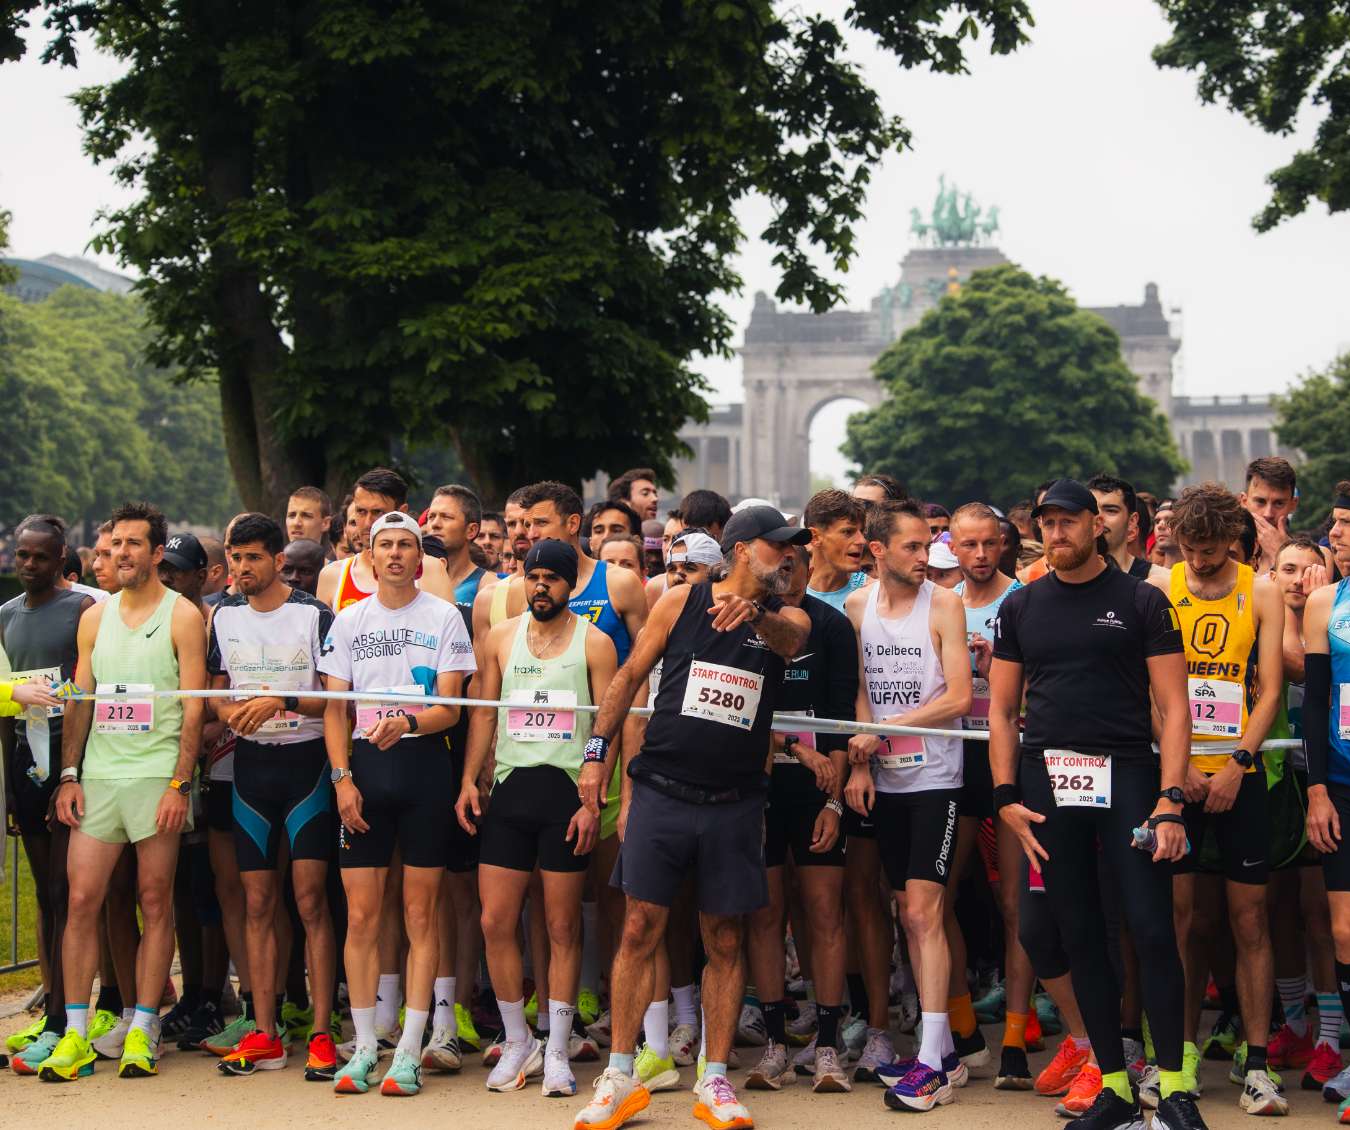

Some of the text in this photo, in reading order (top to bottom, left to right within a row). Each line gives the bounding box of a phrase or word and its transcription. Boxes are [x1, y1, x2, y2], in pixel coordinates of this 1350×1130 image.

[352, 628, 414, 648] ABSOLUTE
[353, 645, 403, 663] JOGGING
[877, 645, 922, 658] Delbecq
[1186, 660, 1241, 677] UEEN'S
[691, 667, 759, 691] START CONTROL
[698, 687, 746, 711] 5280
[1194, 689, 1217, 698] SPA
[107, 706, 134, 720] 212
[524, 712, 556, 727] 207
[1194, 703, 1216, 720] 12
[1063, 756, 1108, 768] CONTROL
[939, 800, 957, 861] DECATHLON
